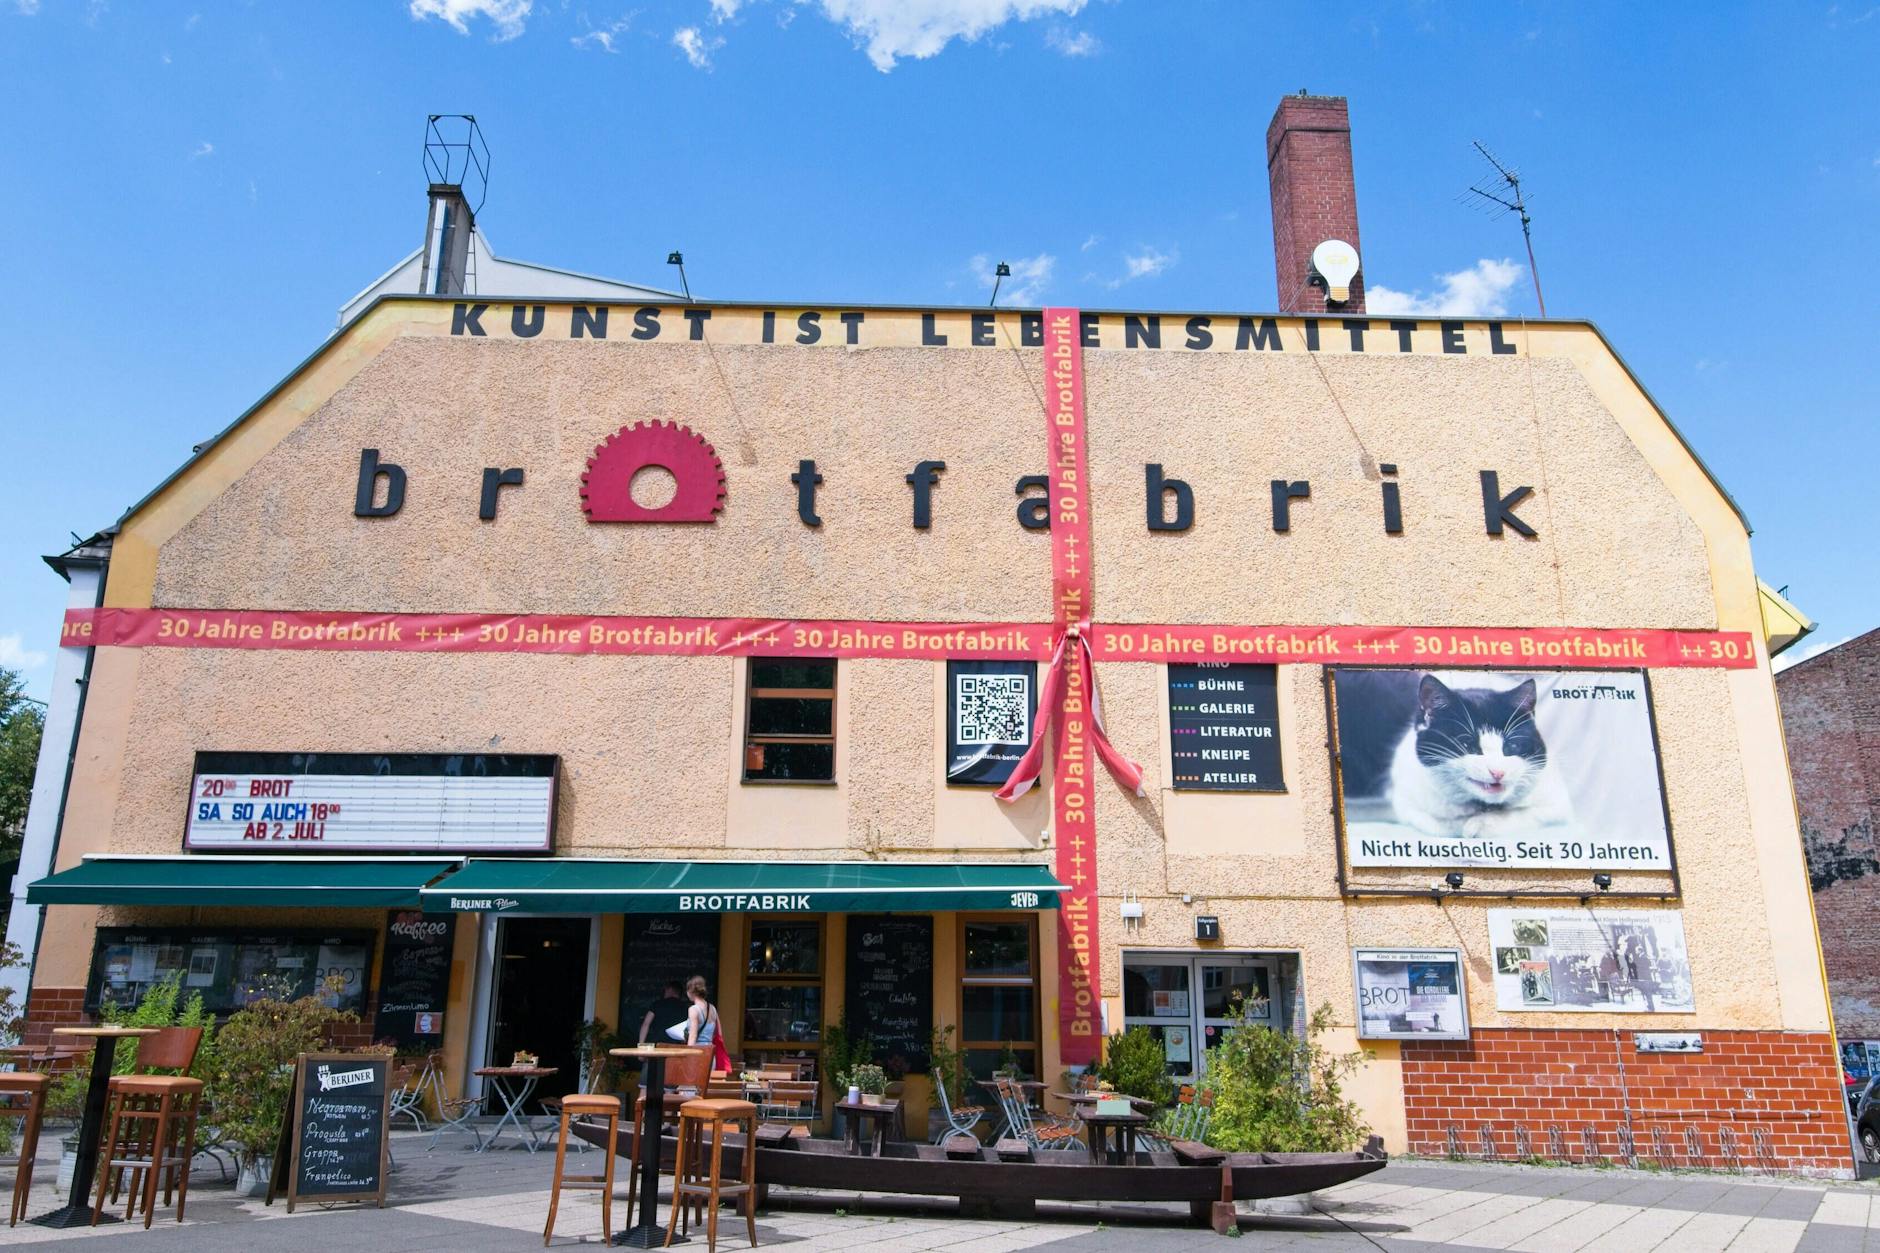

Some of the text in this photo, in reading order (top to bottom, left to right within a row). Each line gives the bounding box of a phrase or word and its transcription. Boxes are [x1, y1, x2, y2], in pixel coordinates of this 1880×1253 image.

[451, 303, 1518, 357] KUNST IST LEBENSMITTEL
[1051, 314, 1079, 523] 30 Jahre Brotfabrik
[158, 618, 189, 640] 30
[193, 619, 264, 642] Jahre
[270, 620, 402, 643] Brotfabrik
[478, 623, 508, 644] 30
[513, 623, 581, 645] Jahre
[589, 623, 719, 648] Brotfabrik
[793, 629, 823, 649] 30
[828, 629, 895, 650] Jahre
[902, 630, 1031, 653] Brotfabrik
[1104, 634, 1134, 653] 30
[1138, 633, 1206, 656] Jahre
[1214, 633, 1340, 656] Brotfabrik
[1413, 635, 1442, 655] 30
[1447, 635, 1512, 656] Jahre
[1520, 637, 1647, 659] Brotfabrik
[1710, 640, 1738, 660] 30
[1197, 678, 1245, 692] BÜHNE
[1199, 703, 1256, 714] GALERIE
[1201, 726, 1273, 738] LITERATUR
[1062, 721, 1085, 791] Jahre
[1202, 749, 1251, 761] KNEIPE
[1203, 772, 1257, 784] ATELIER
[249, 779, 293, 798] BROT
[198, 803, 222, 821] SA
[231, 803, 255, 821] SO
[261, 803, 307, 821] AUCH
[1065, 794, 1087, 824] 30
[243, 822, 268, 841] AB
[287, 822, 325, 841] JULI
[1361, 839, 1659, 863] Nicht kuschelig. Seit 30 Jahren.
[450, 897, 492, 911] BERLINER
[679, 895, 811, 911] BROTFABRIK
[1010, 893, 1039, 908] JEVER
[391, 921, 447, 940] Kaffee
[1206, 924, 1211, 936] 1
[1066, 896, 1092, 1037] Brotfabrik
[1360, 987, 1410, 1007] BROT
[331, 1071, 371, 1086] BERLINER
[304, 1146, 339, 1166] Grappa
[304, 1166, 352, 1185] Frangelico
